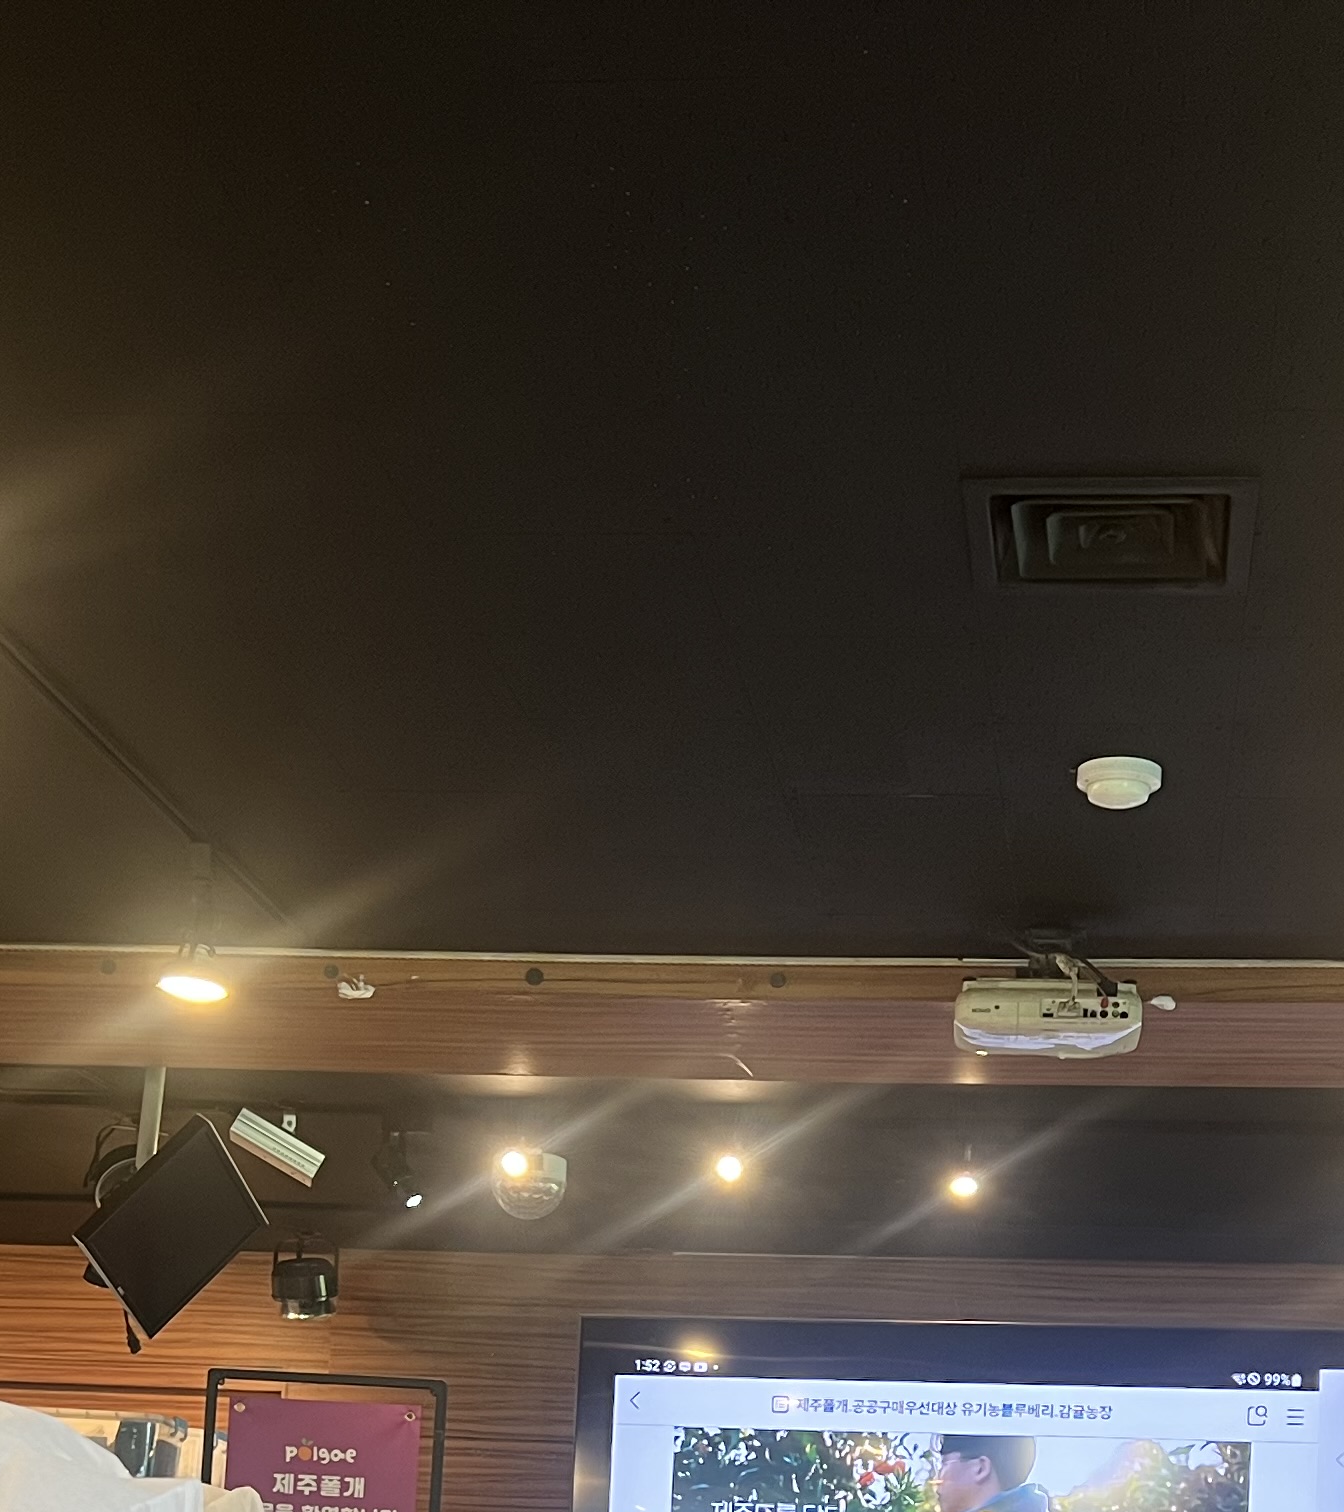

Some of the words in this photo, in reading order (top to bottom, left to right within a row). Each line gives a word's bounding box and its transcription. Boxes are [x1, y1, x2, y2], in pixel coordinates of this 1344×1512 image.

[635, 1359, 661, 1373] 1:52
[1264, 1372, 1291, 1386] 99%
[272, 1472, 366, 1499] 제주폴개
